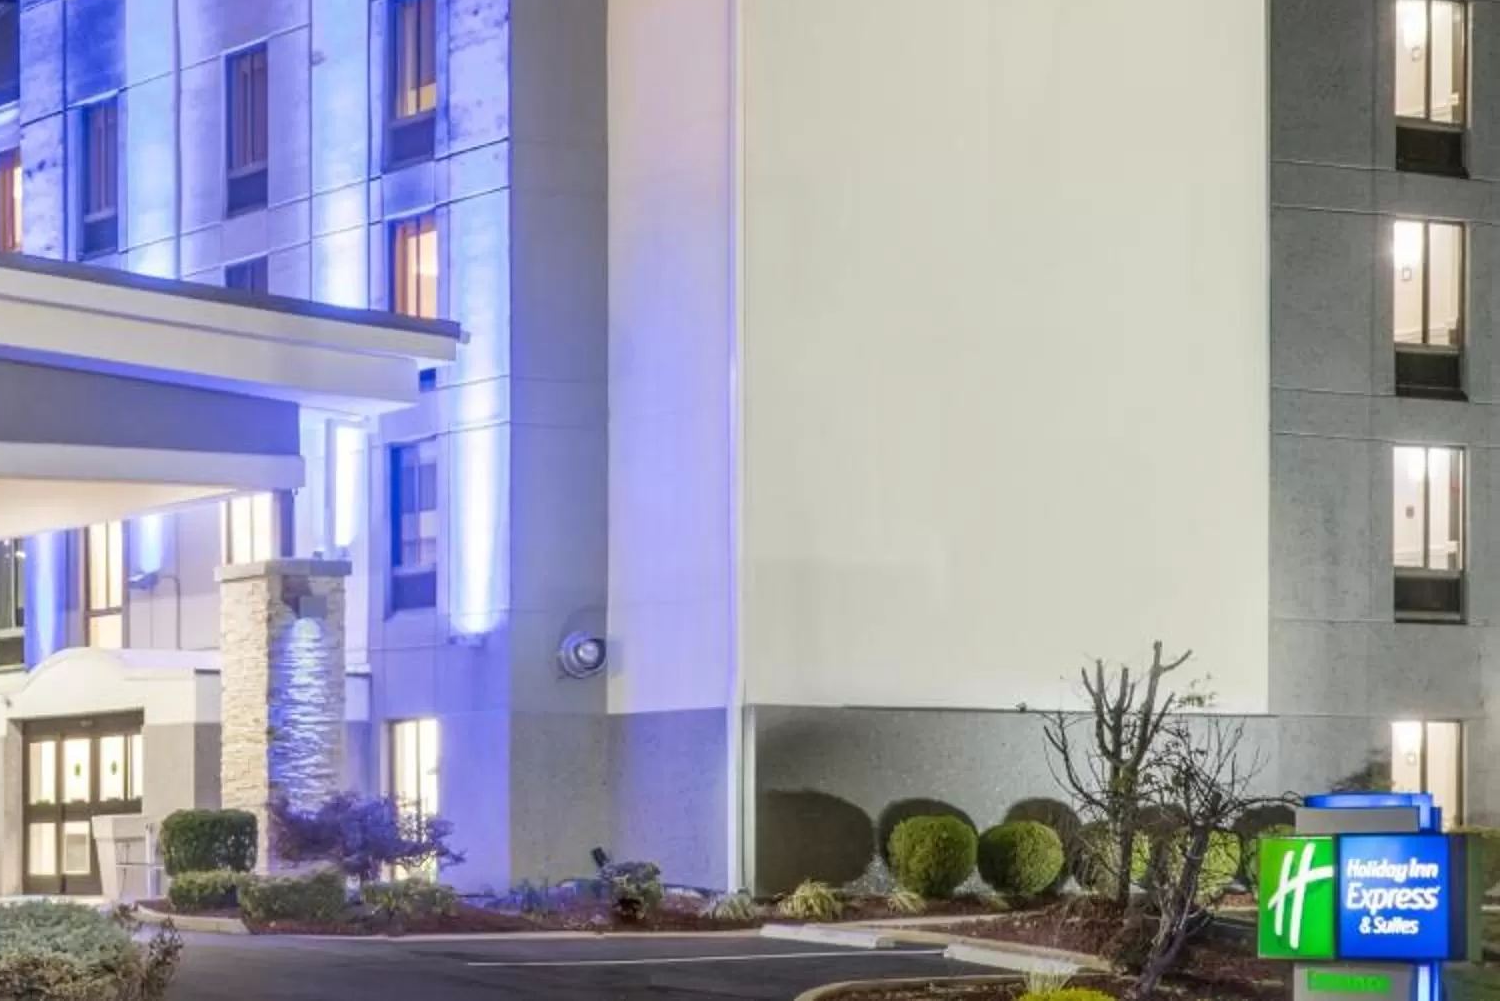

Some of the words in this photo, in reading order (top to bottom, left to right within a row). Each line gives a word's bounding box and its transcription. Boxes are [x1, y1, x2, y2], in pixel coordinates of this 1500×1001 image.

[1347, 857, 1408, 883] Holiday
[1409, 856, 1439, 878] Inn
[1346, 882, 1439, 916] Express
[1359, 916, 1372, 935] &
[1372, 916, 1420, 935] Suites
